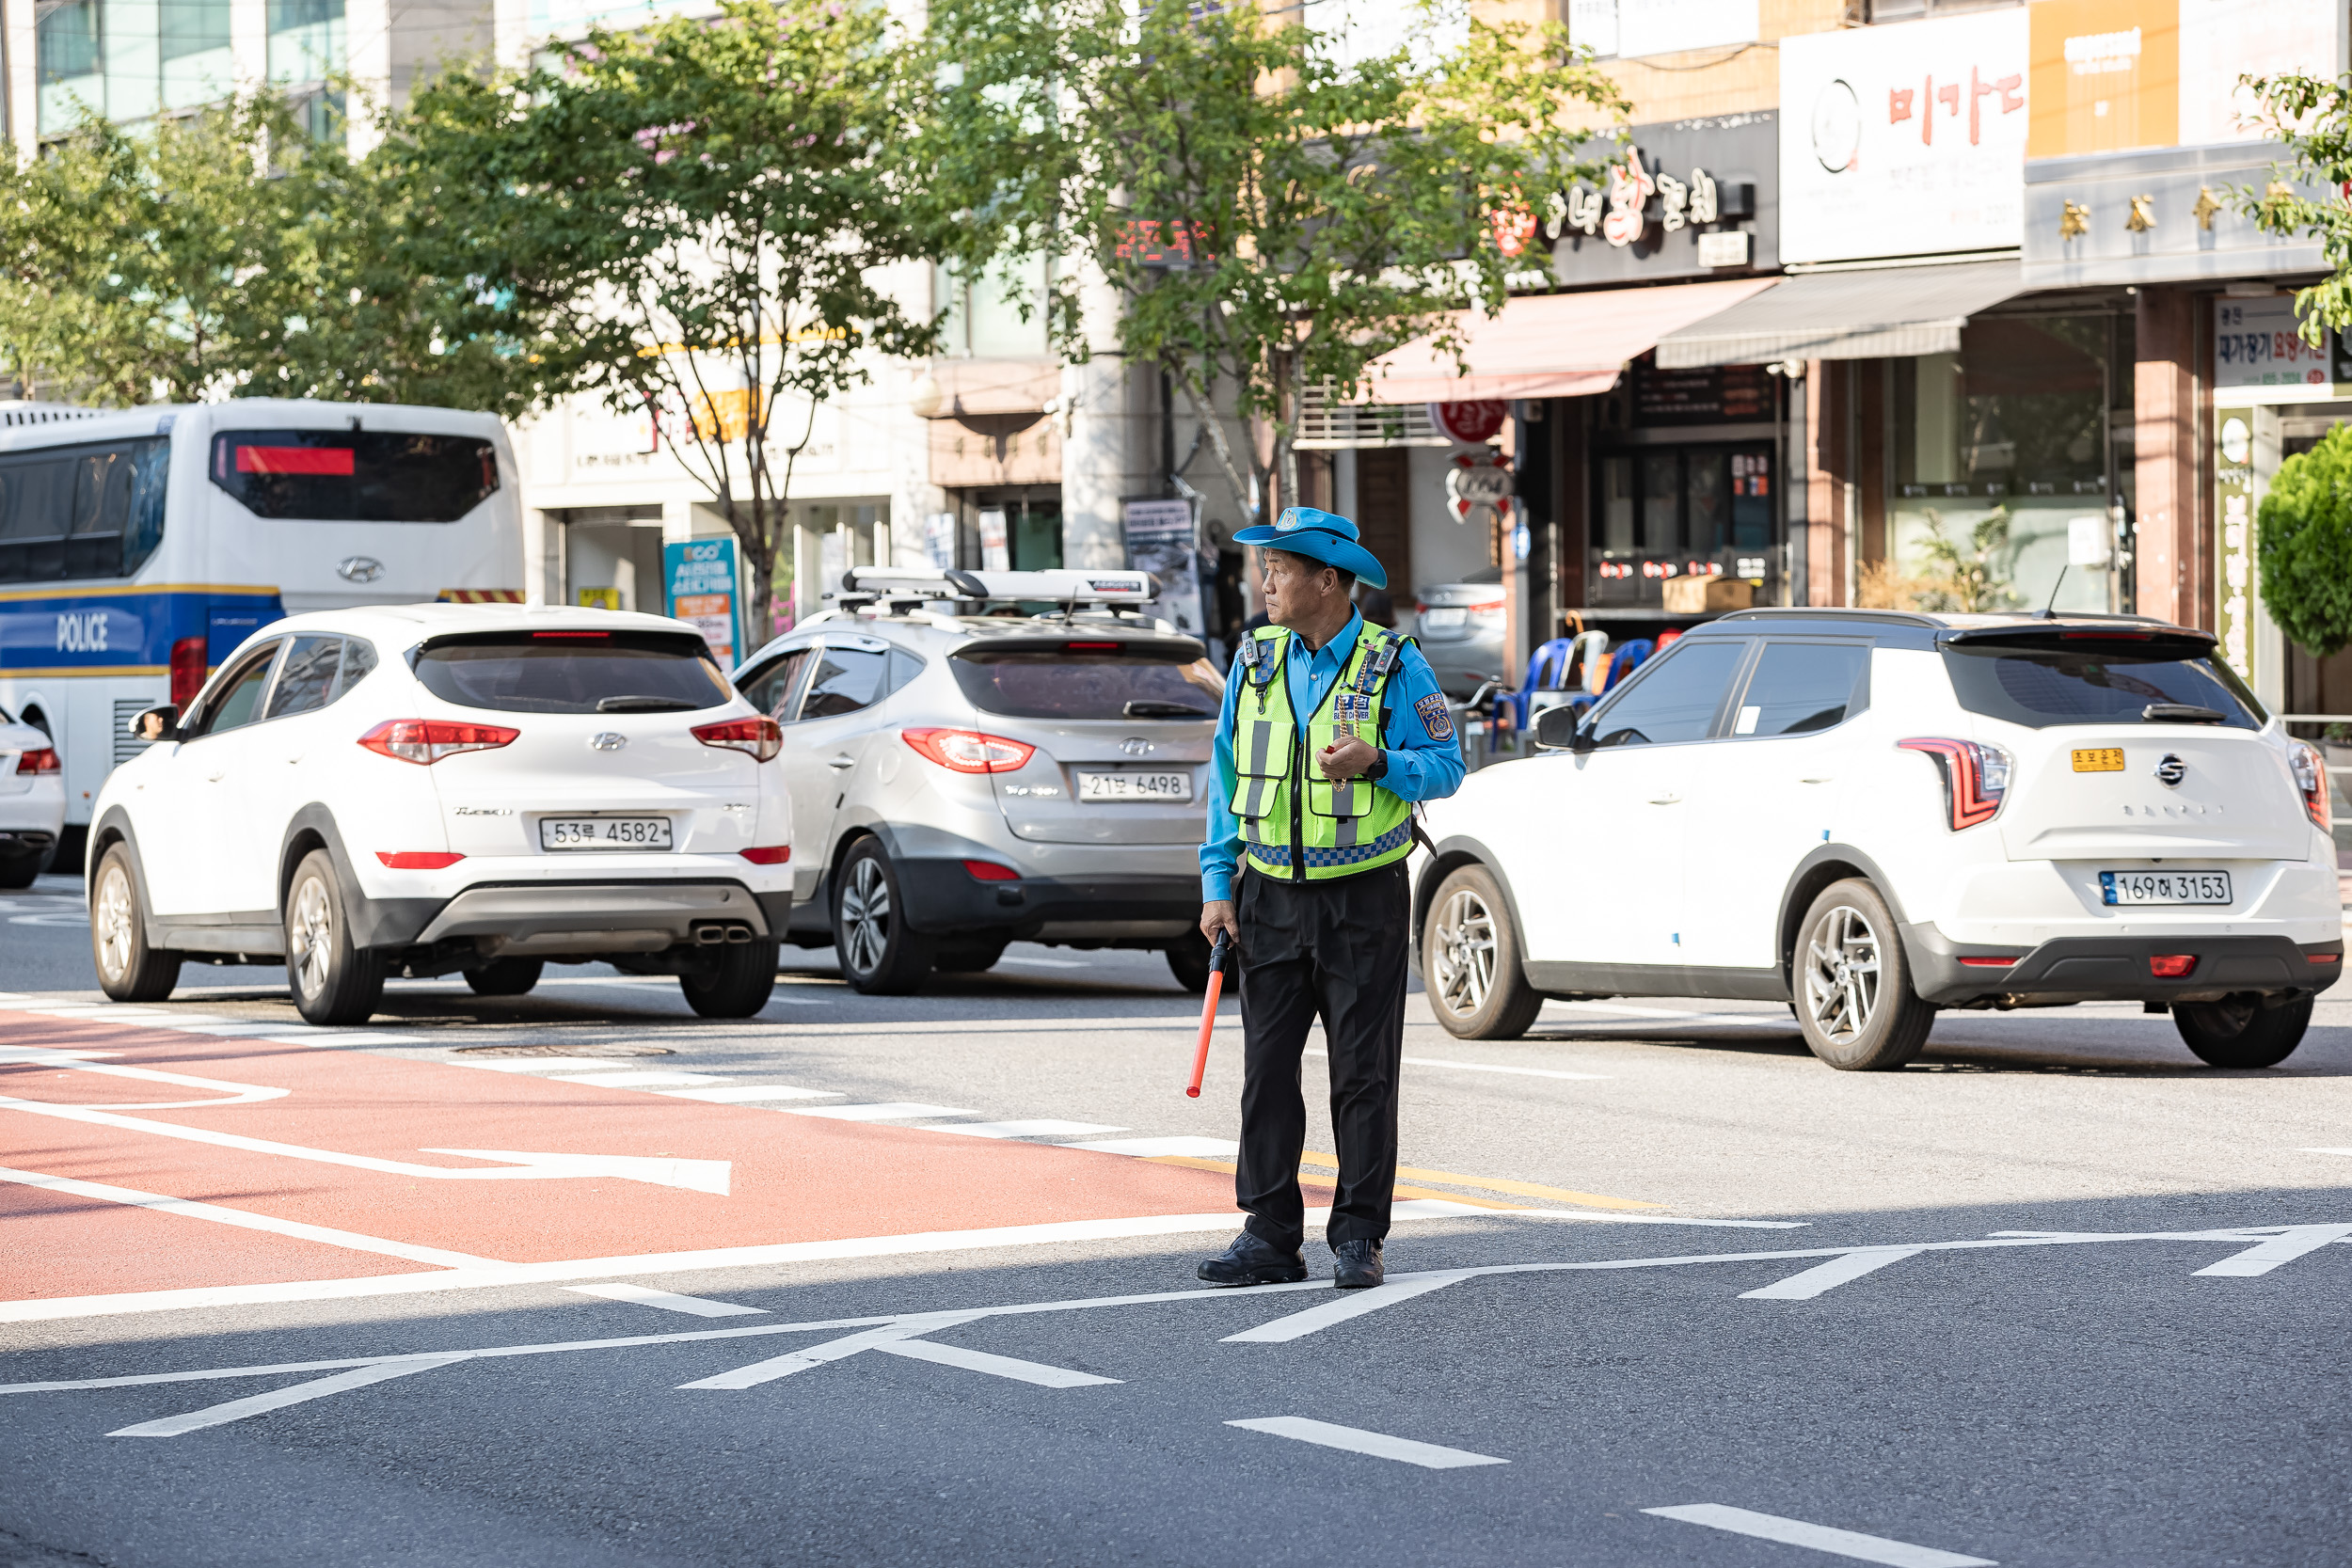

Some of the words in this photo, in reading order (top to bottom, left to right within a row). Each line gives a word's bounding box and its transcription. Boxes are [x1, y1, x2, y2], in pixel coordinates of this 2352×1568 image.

[56, 612, 108, 653] POLICE
[1136, 776, 1182, 795] 6498
[554, 822, 596, 844] 53루
[606, 821, 660, 843] 4582
[2119, 876, 2172, 900] 169허
[2176, 876, 2225, 899] 3153
